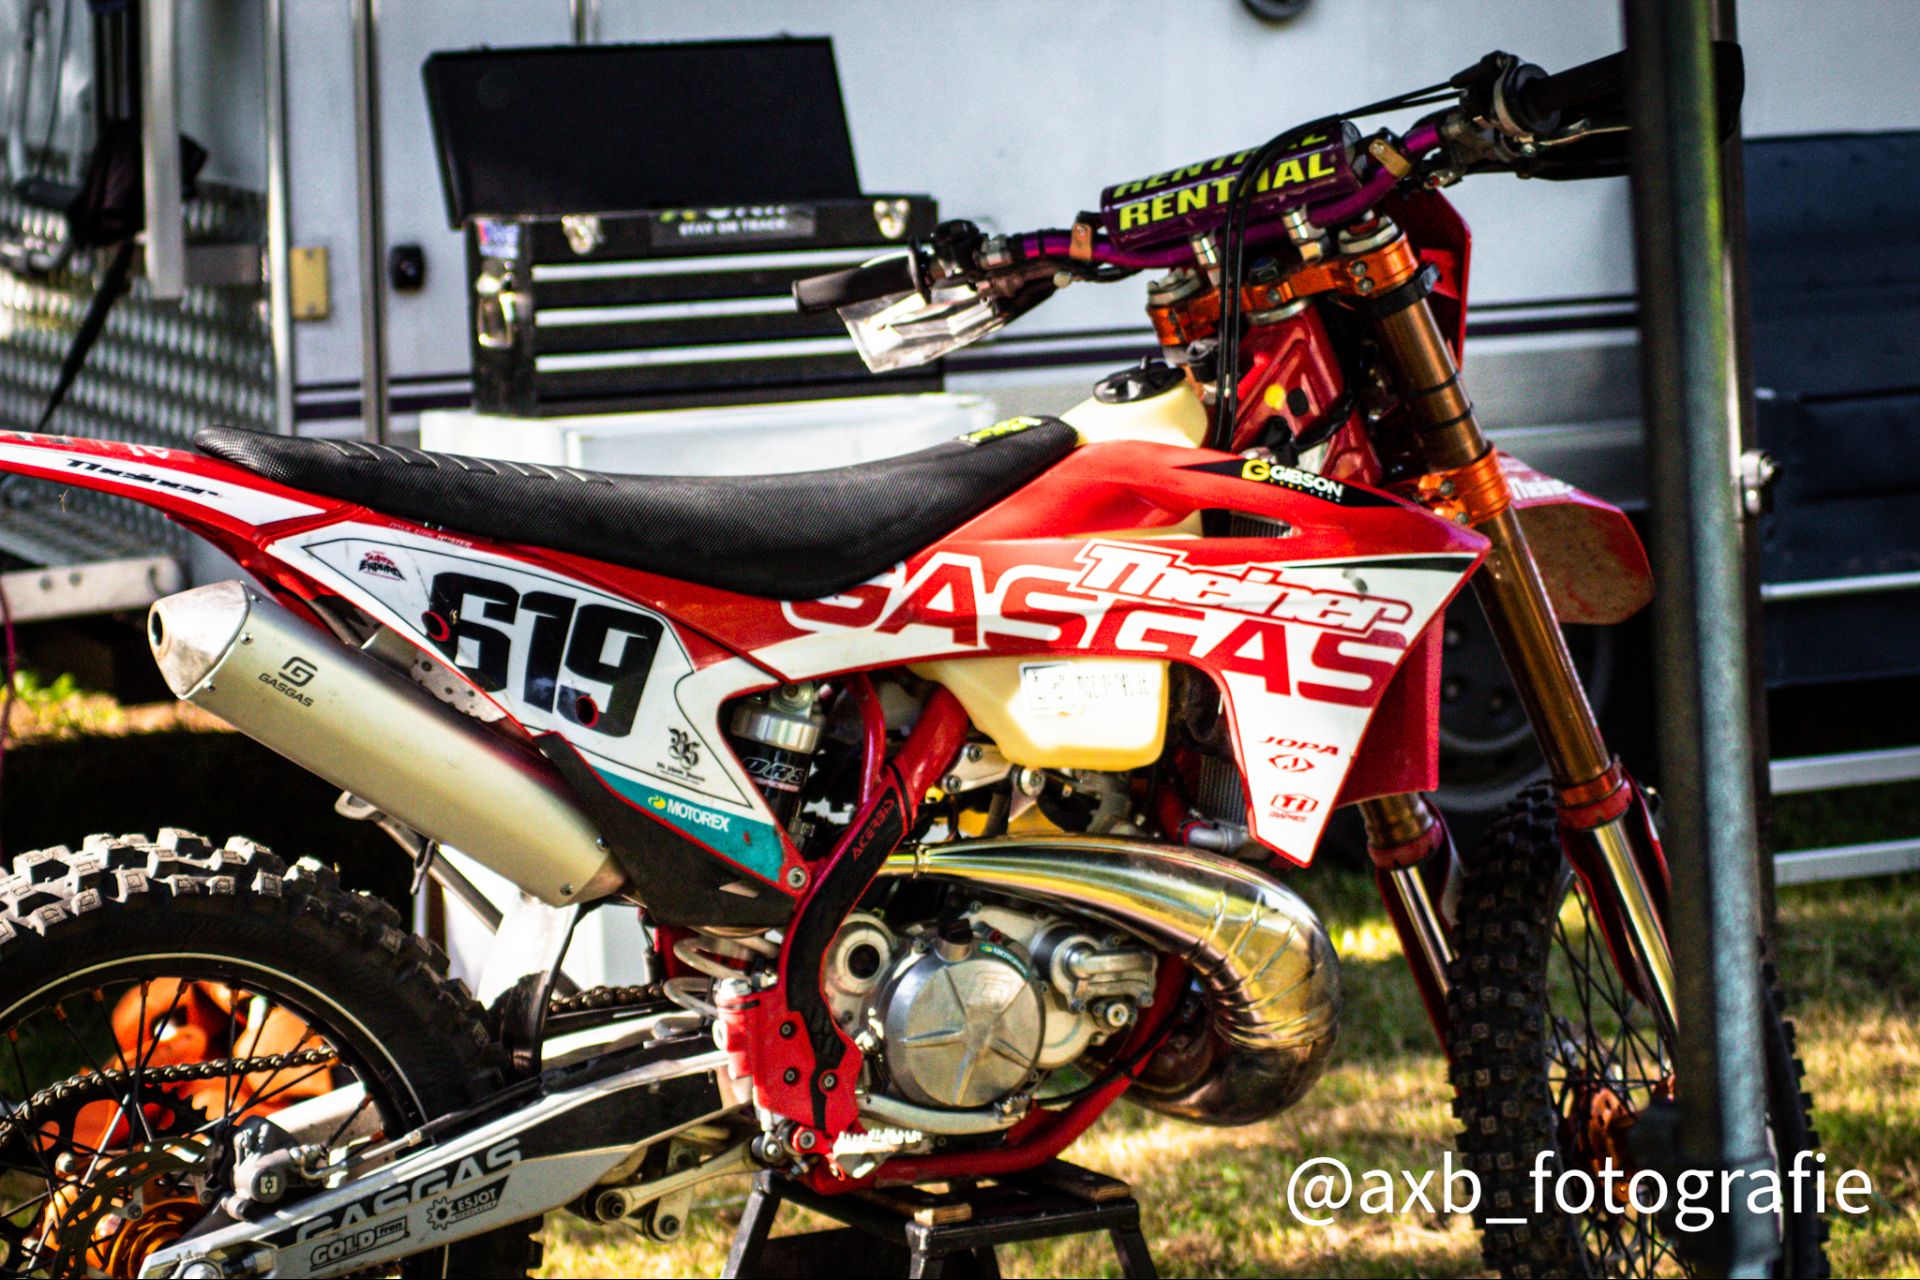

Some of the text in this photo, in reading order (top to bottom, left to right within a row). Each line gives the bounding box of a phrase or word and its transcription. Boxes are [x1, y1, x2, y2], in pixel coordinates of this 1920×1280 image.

[1270, 465, 1344, 498] GIBSON
[1067, 537, 1413, 637] Theiner
[783, 550, 1411, 709] GASGAS
[428, 571, 665, 739] 619
[258, 672, 315, 708] GASGAS
[1258, 736, 1339, 756] JOPA
[666, 798, 731, 833] MOTOREX
[296, 1138, 522, 1245] GASGAS
[458, 1187, 497, 1213] ESJOT
[309, 1228, 377, 1267] GOLD
